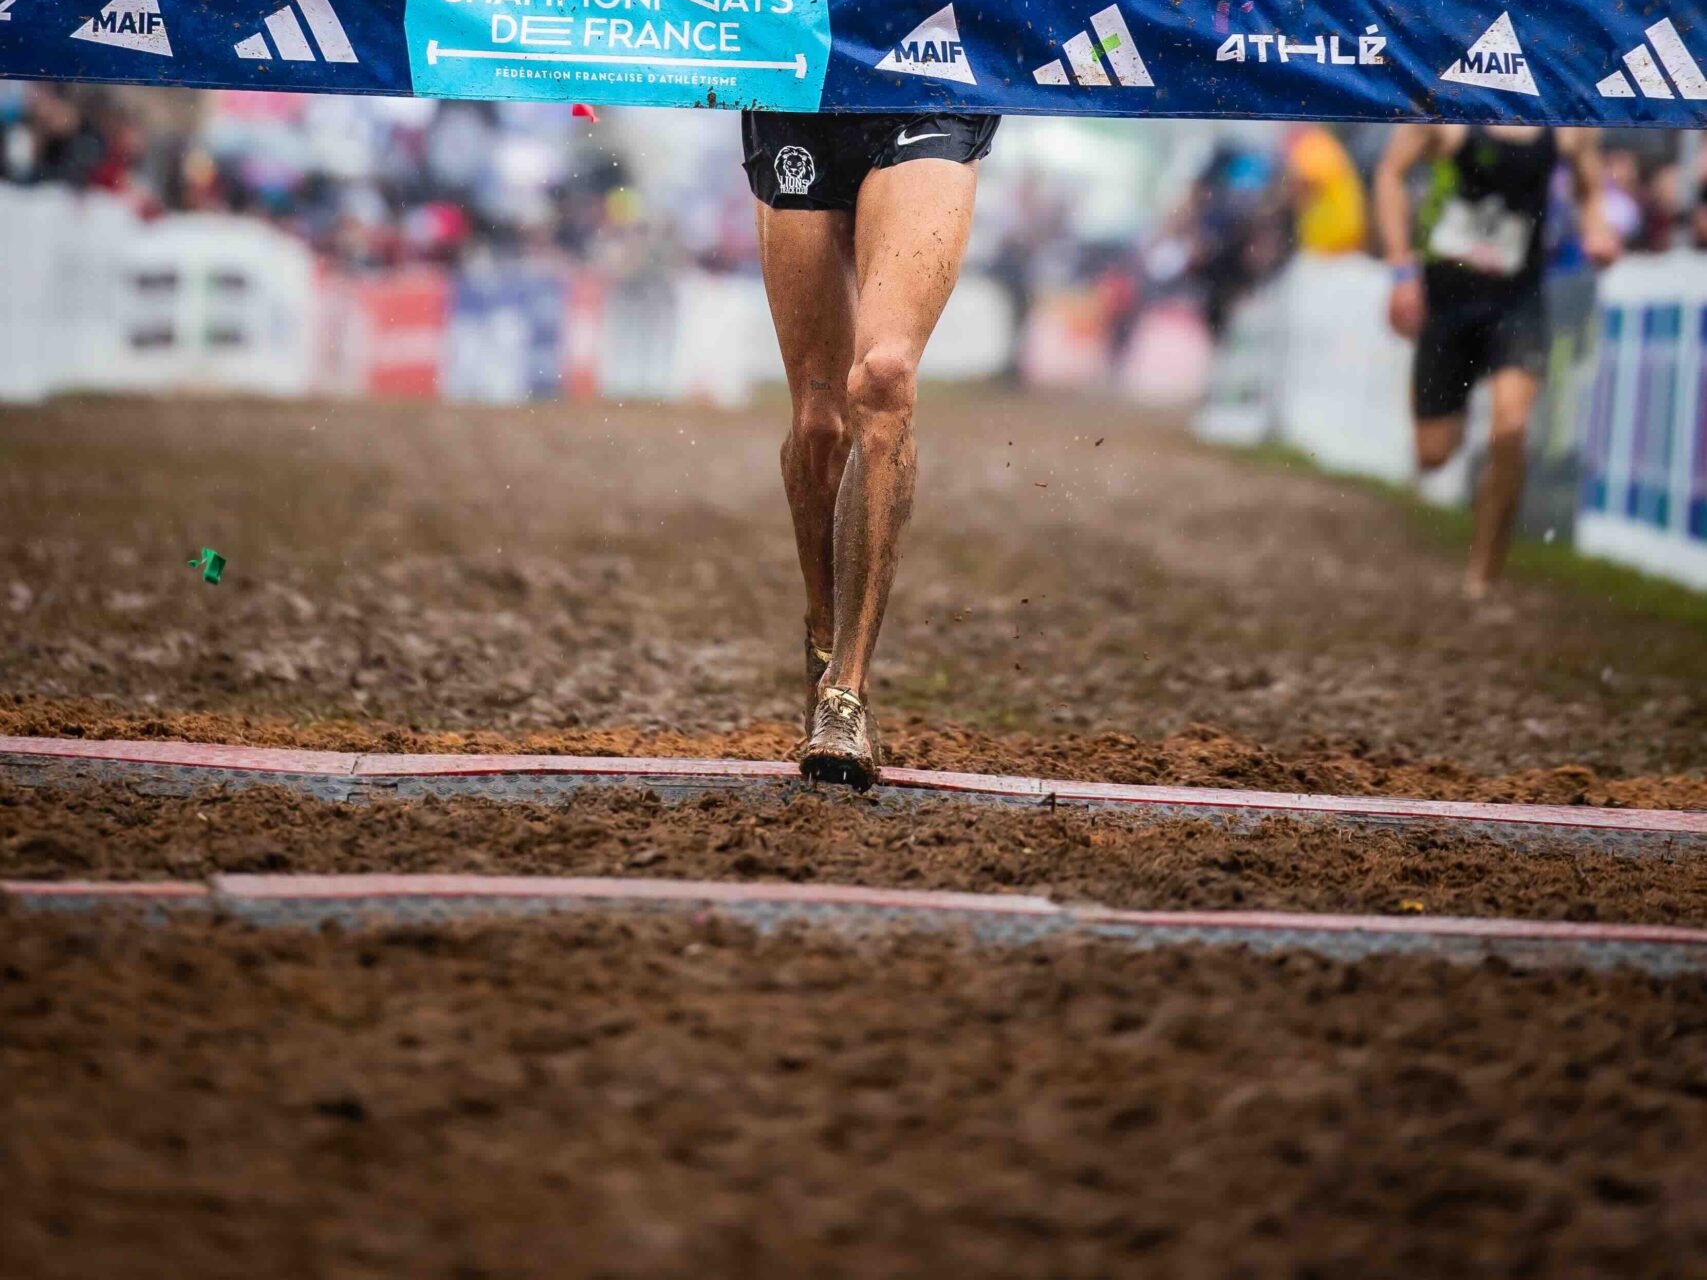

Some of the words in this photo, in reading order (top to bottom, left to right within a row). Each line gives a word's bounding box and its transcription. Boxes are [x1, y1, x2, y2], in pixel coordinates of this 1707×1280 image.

[92, 11, 163, 35] MAIF
[491, 14, 574, 46] DE
[583, 18, 741, 52] FRANCE
[893, 40, 963, 64] MAIF
[1216, 23, 1387, 65] ATHLÉ
[1459, 51, 1526, 75] MAIF
[495, 66, 571, 80] FÉDÉRATION
[575, 72, 643, 84] FRANÇAISE
[647, 72, 737, 86] D'ATHLÉTISME
[780, 176, 809, 188] LIONS
